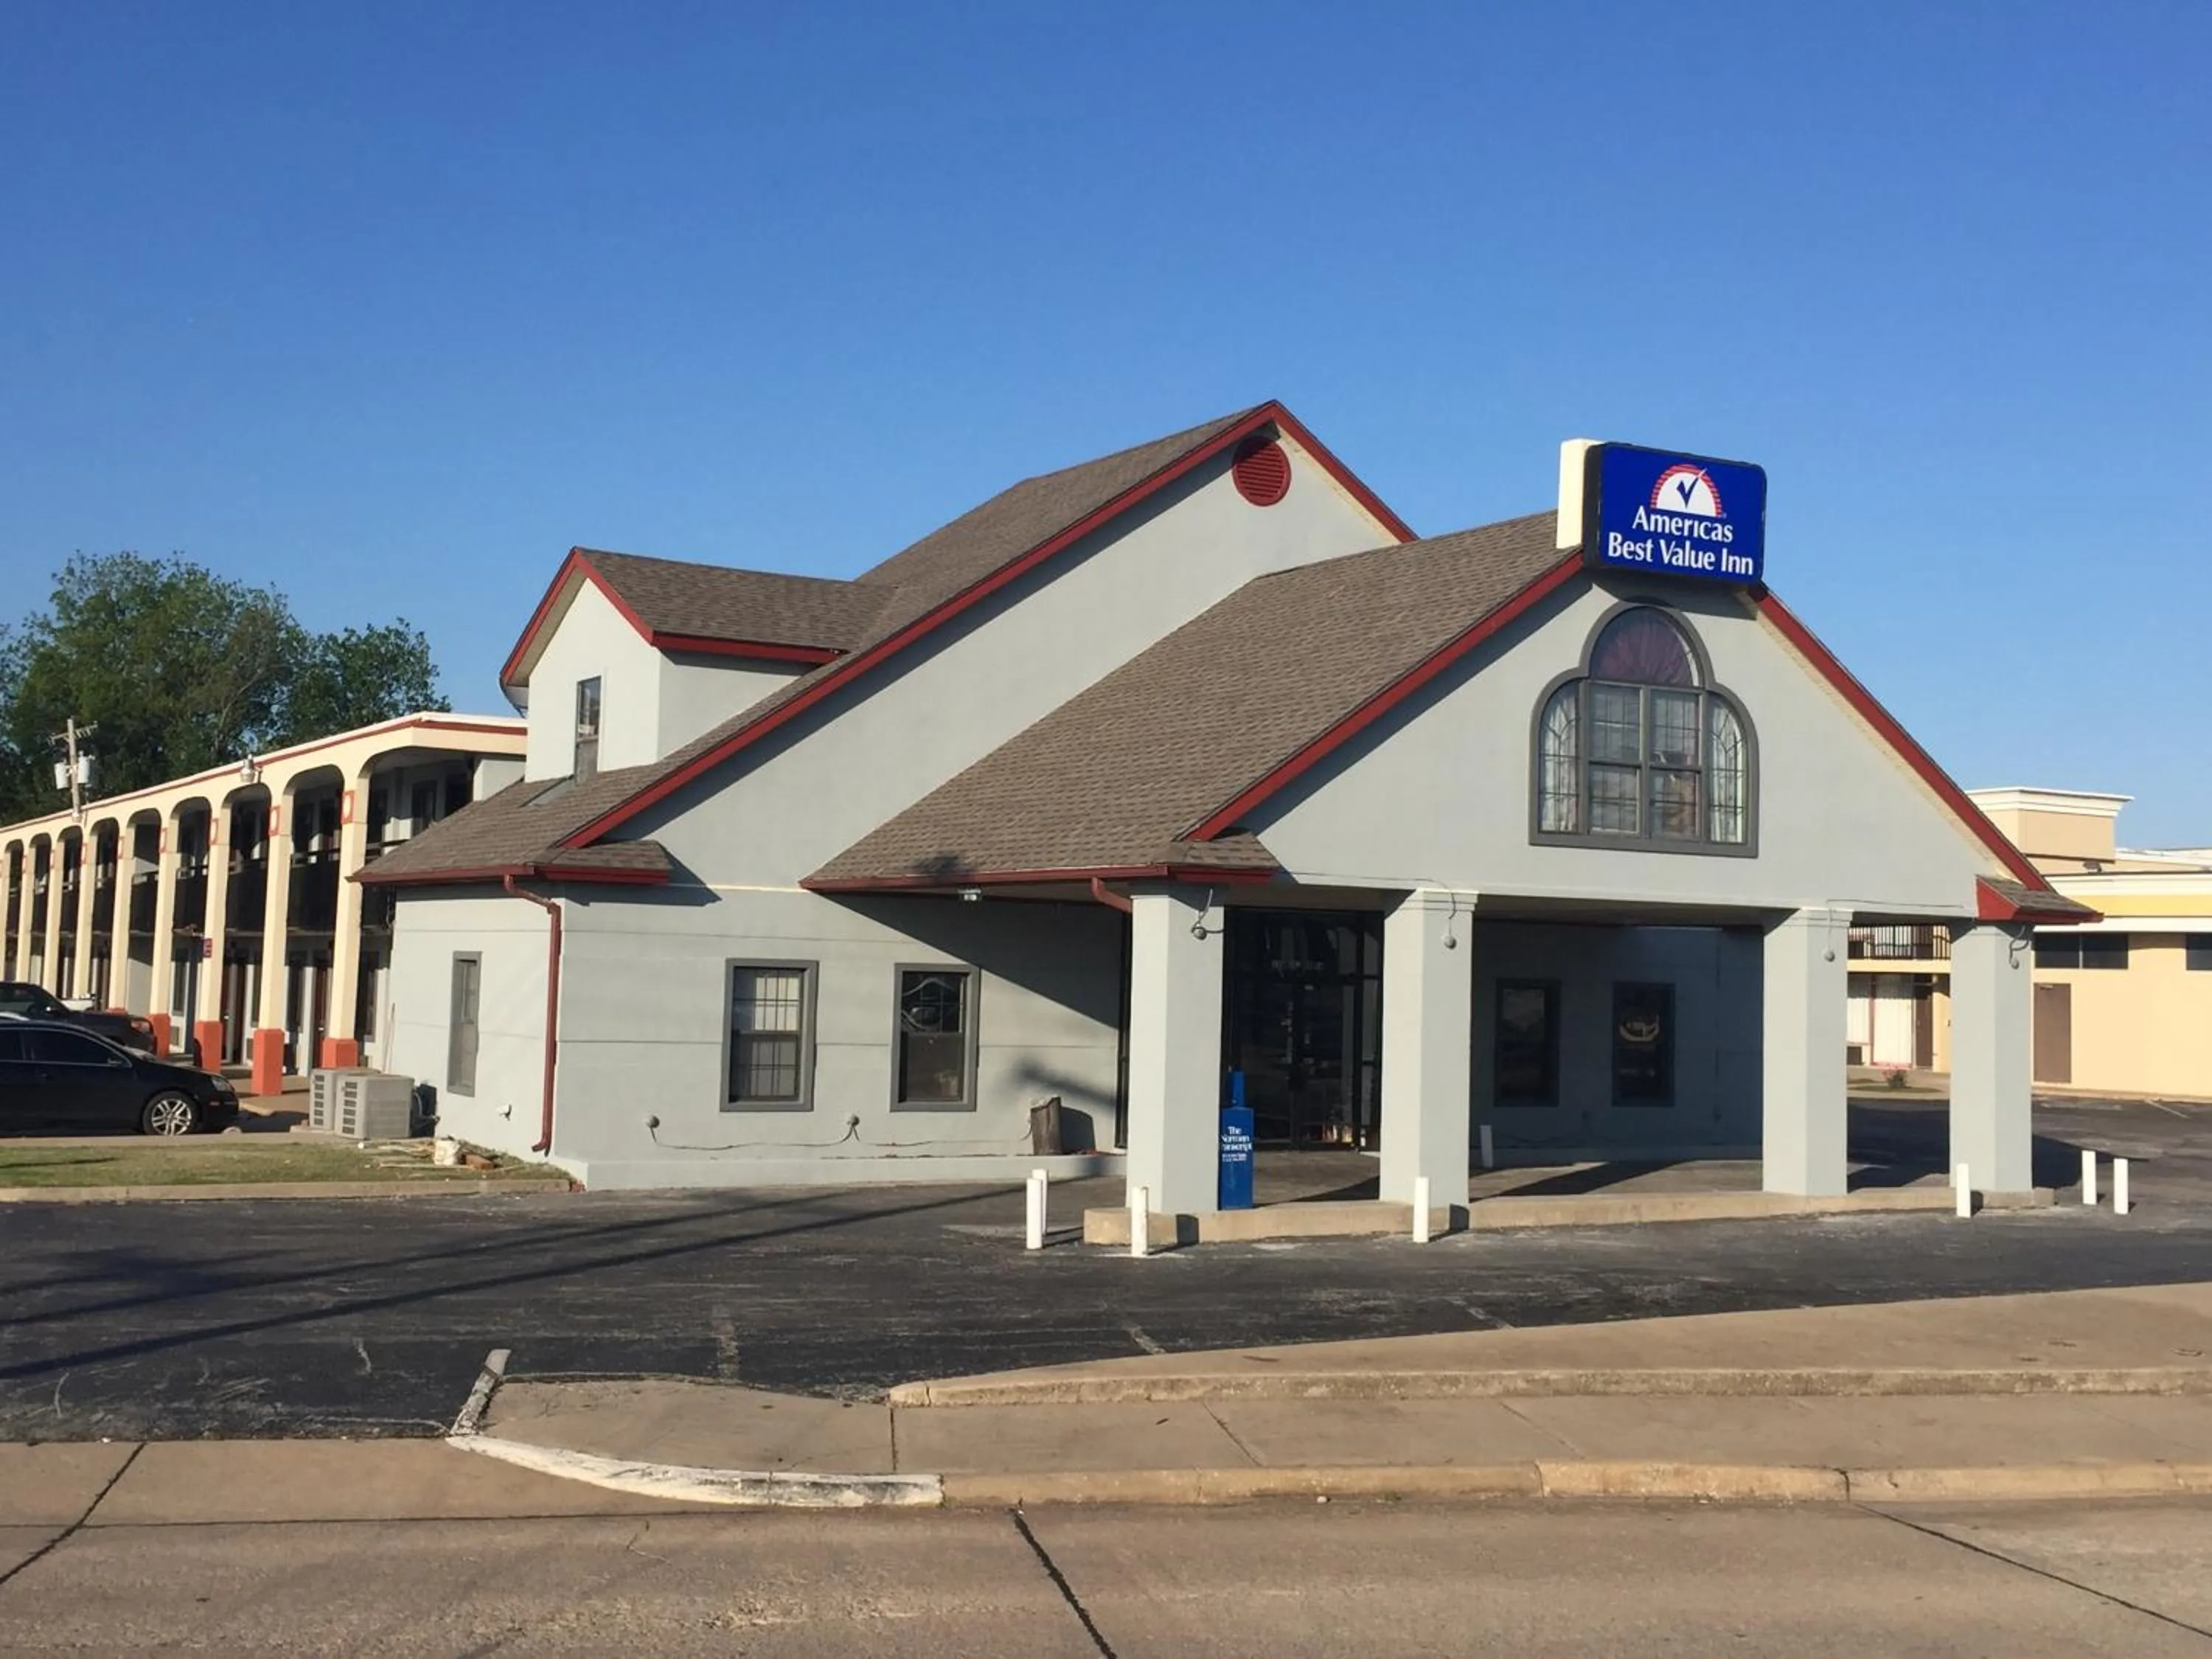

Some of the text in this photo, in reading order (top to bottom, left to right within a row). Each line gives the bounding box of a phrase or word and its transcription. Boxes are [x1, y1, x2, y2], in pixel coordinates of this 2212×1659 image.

[1632, 505, 1733, 543] Americas
[1608, 532, 1753, 575] Best Value Inn
[1227, 1126, 1242, 1135] The
